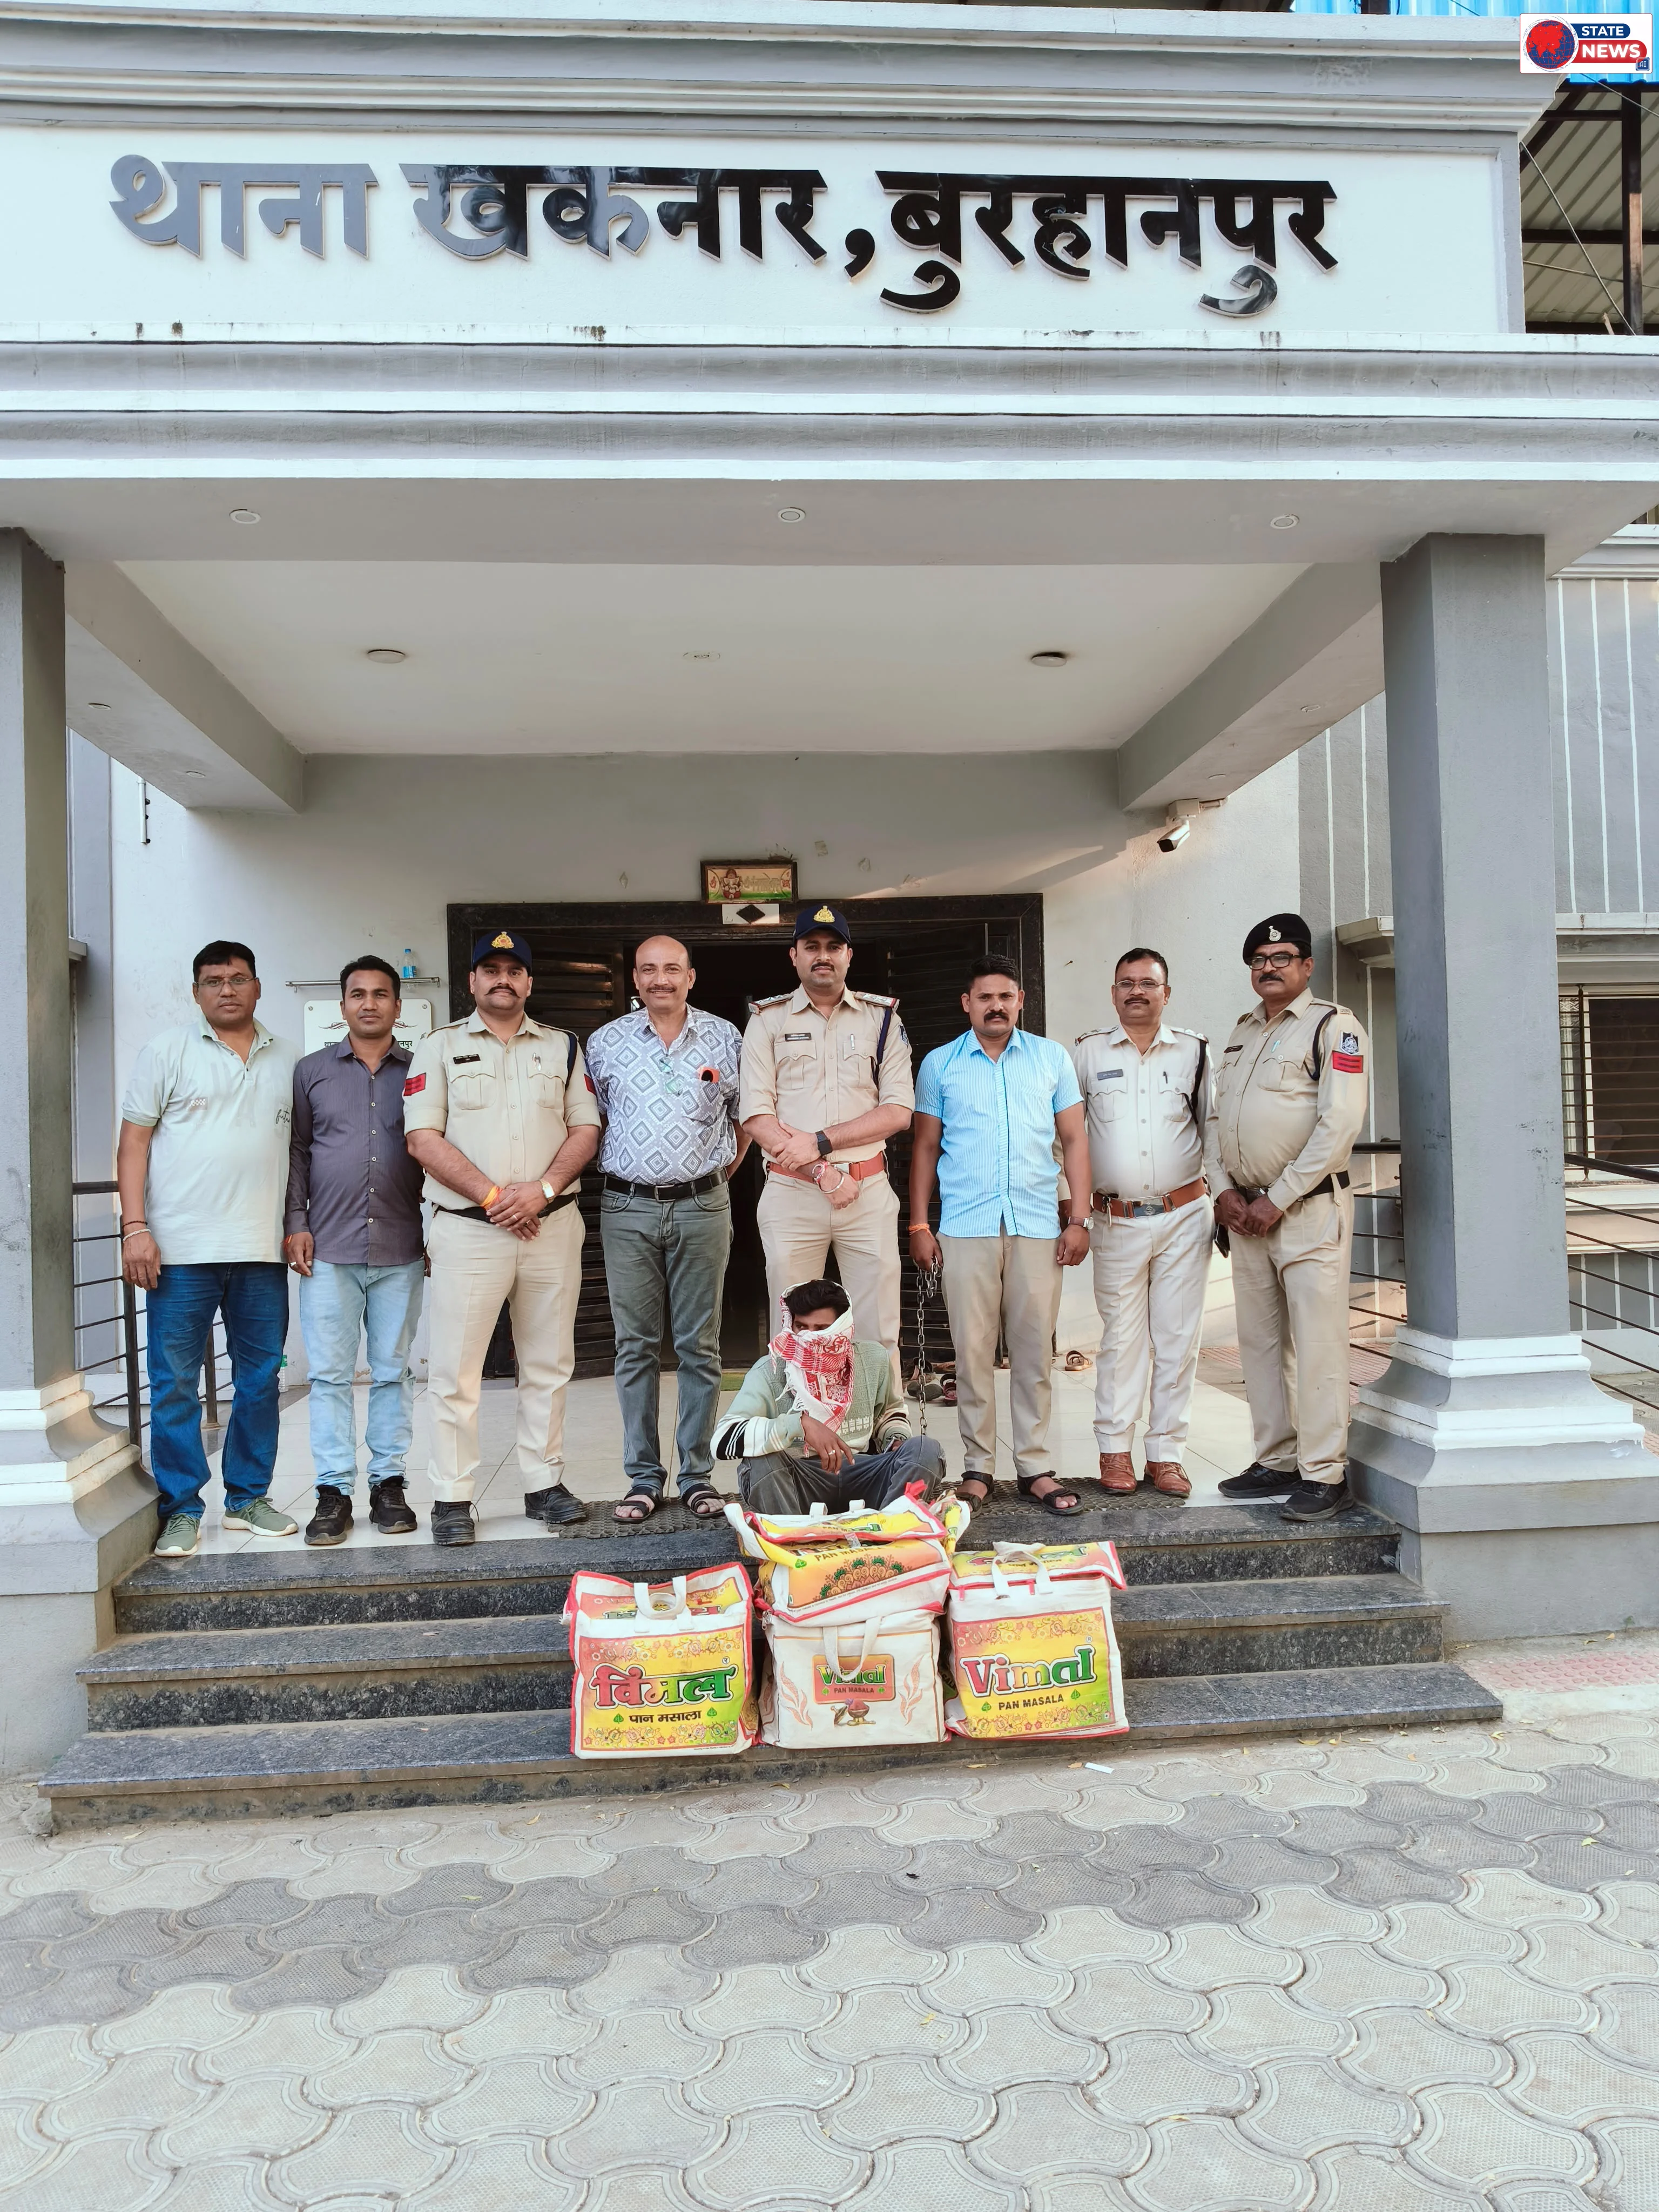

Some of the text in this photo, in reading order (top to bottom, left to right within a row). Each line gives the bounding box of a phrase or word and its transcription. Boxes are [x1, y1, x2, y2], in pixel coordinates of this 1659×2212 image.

[109, 154, 380, 260] थाना
[589, 1663, 738, 1708] विमल
[961, 1644, 1096, 1696] Vimal
[628, 1710, 702, 1723] पान मसाला
[998, 1694, 1064, 1711] PAN MASALA
